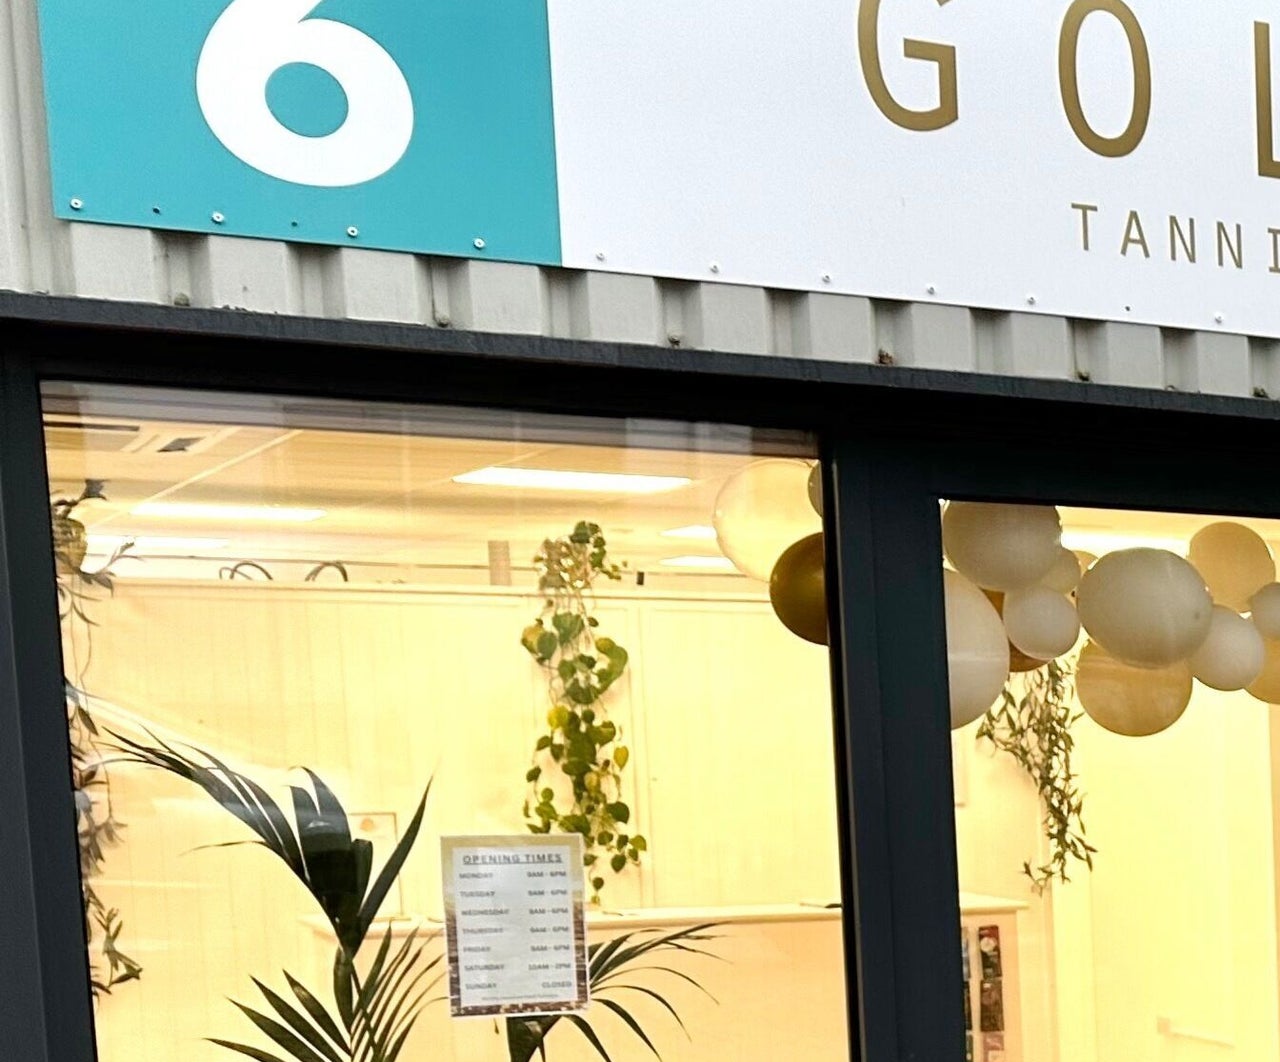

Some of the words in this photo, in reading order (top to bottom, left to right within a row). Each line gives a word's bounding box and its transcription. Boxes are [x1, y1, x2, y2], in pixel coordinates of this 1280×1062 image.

[196, 0, 414, 188] 6
[463, 854, 520, 865] OPENING
[526, 853, 562, 863] TIMES
[466, 982, 497, 990] SUNDAY
